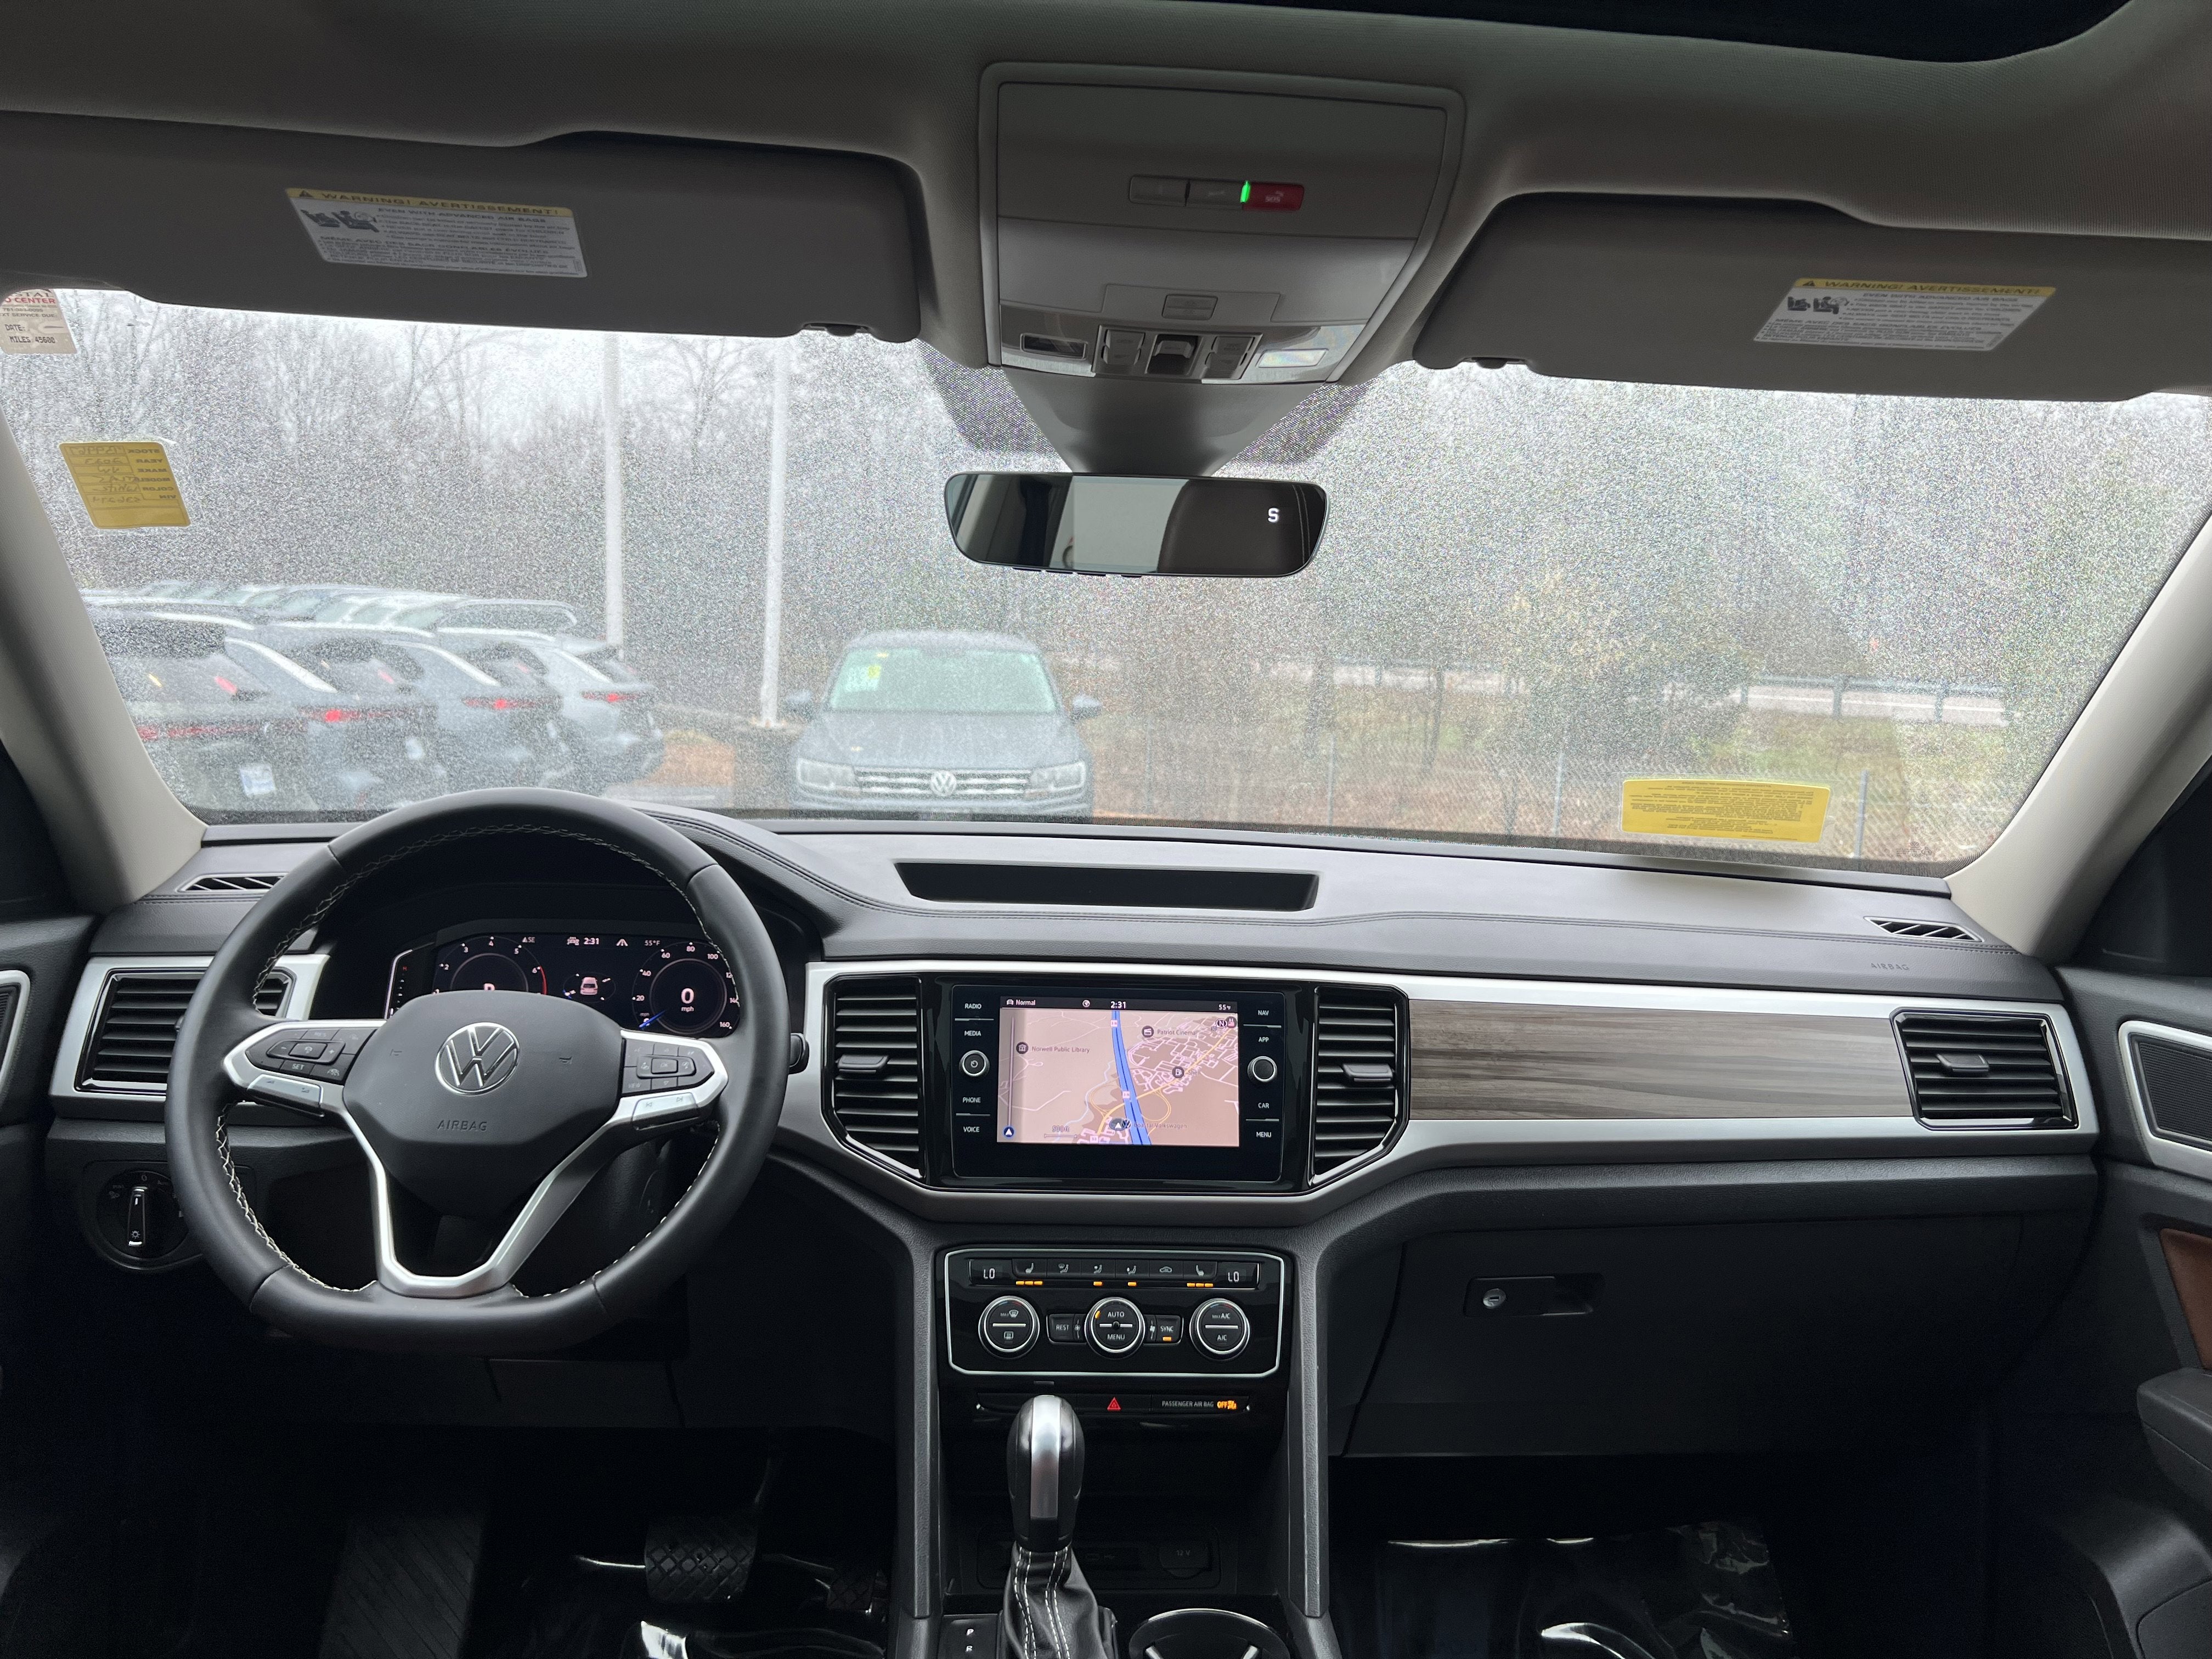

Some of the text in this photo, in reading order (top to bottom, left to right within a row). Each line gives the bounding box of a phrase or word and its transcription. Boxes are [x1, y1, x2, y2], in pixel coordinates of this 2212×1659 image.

[321, 194, 558, 215] WARNING! AVERTISSEMENT!
[1906, 284, 2040, 295] AVERTISSEMENT!
[1268, 507, 1279, 523] S
[680, 988, 695, 1004] 0
[1110, 1001, 1126, 1009] 2:31
[437, 1120, 487, 1131] AIRBAG
[983, 1268, 995, 1279] LO
[1228, 1271, 1239, 1282] LO
